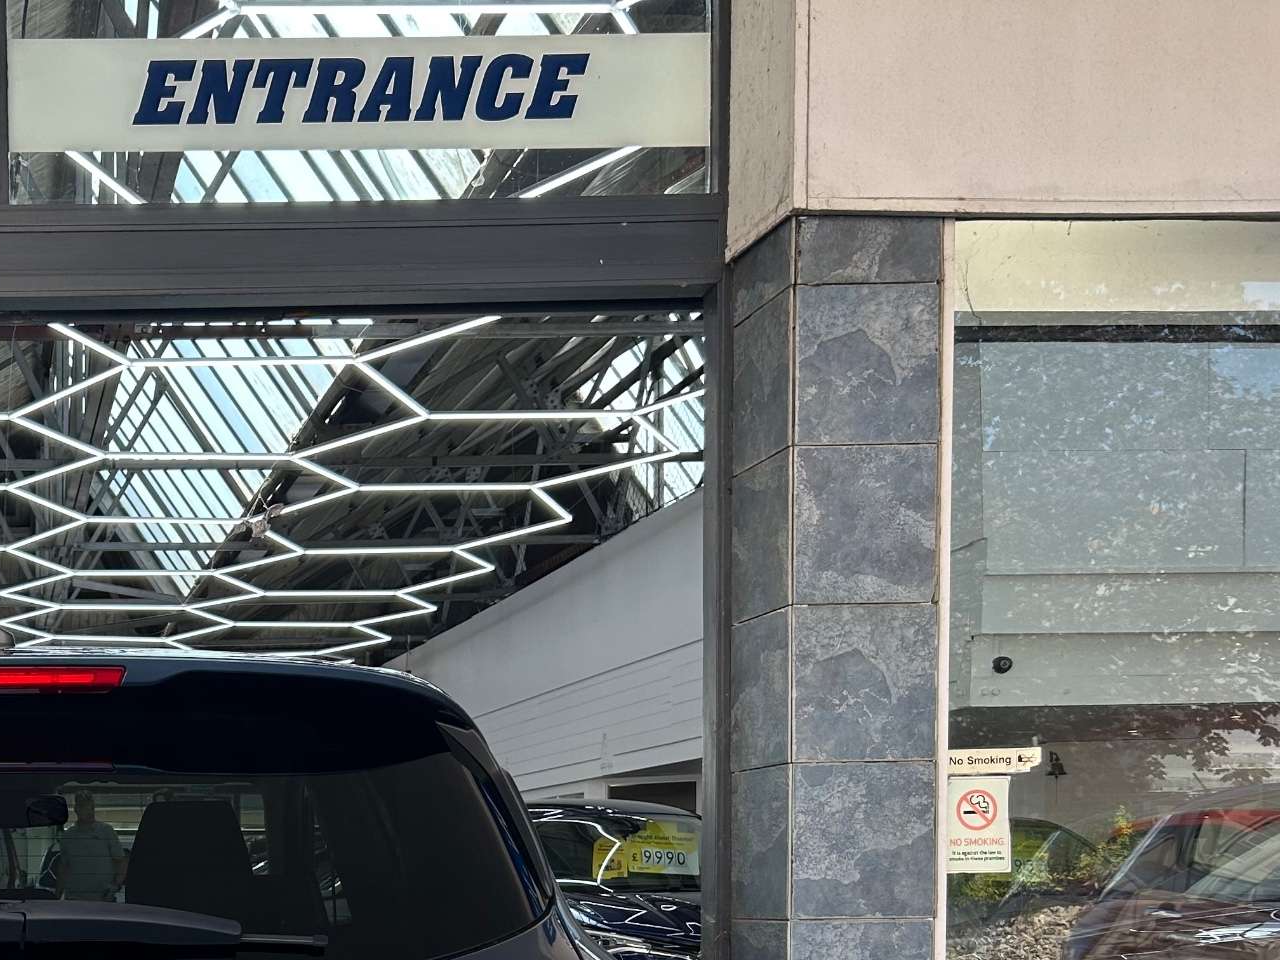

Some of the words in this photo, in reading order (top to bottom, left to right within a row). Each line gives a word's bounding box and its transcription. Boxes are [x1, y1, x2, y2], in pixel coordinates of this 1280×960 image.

[132, 53, 590, 126] ENTRANCE
[949, 756, 964, 766] No
[967, 755, 1012, 767] Smoking
[950, 838, 962, 847] NO
[963, 837, 1004, 847] SMOKING
